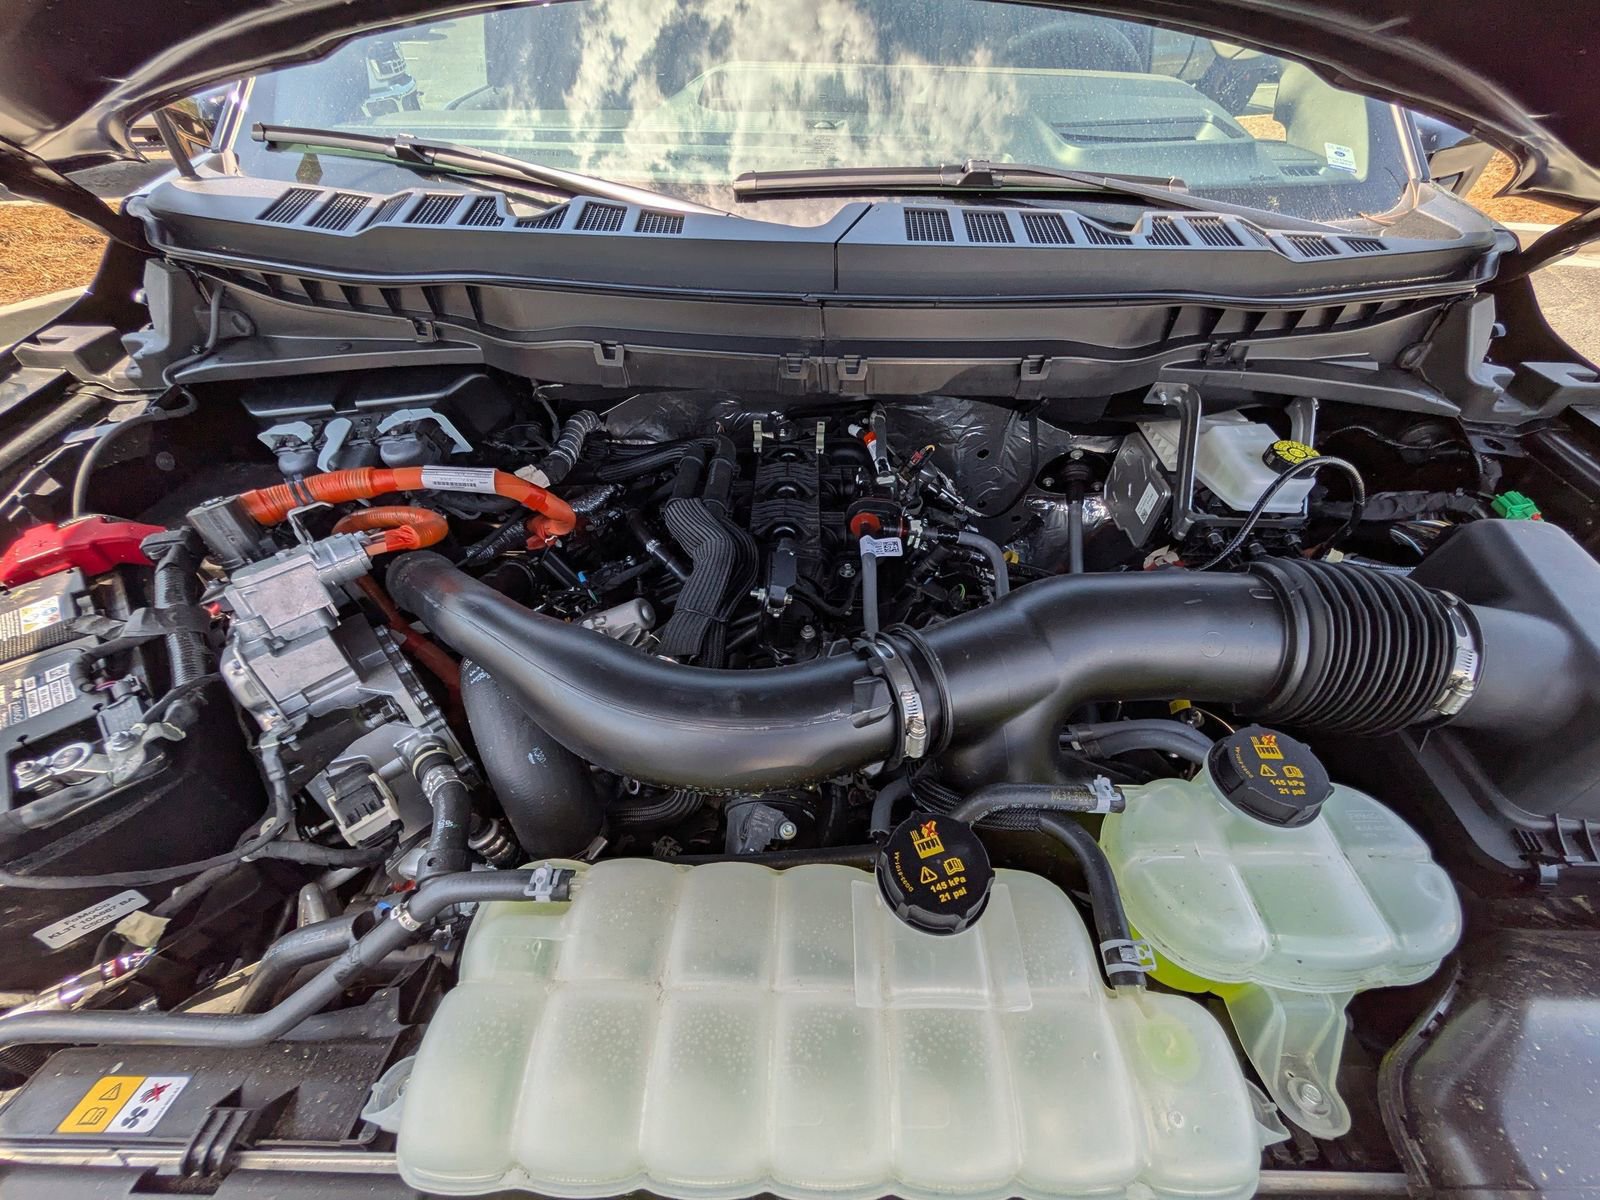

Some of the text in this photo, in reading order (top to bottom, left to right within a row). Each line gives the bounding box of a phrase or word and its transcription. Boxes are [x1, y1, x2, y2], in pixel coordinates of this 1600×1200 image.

[1287, 779, 1305, 787] kPa
[1278, 787, 1306, 796] 21 psi
[930, 876, 966, 892] 145 kPa
[939, 887, 966, 903] 21 psi
[64, 903, 111, 925] FoMoCo
